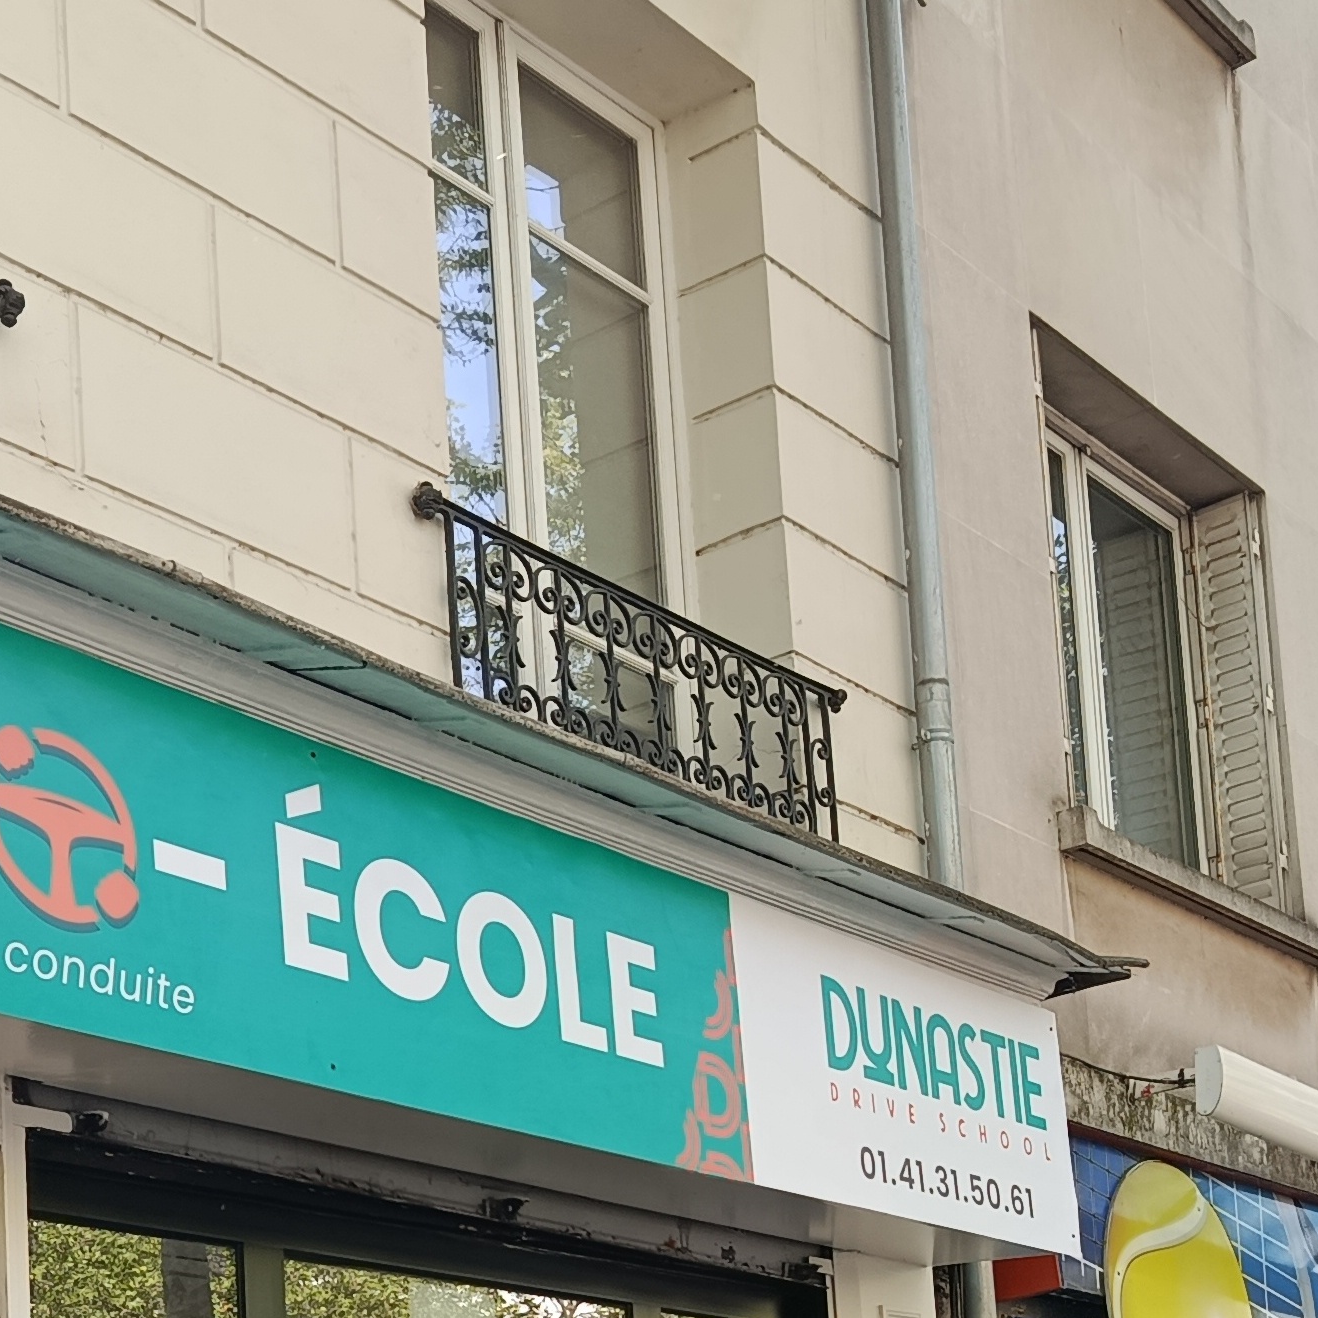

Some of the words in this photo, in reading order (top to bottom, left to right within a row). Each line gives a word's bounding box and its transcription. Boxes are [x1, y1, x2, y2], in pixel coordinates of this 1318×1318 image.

[275, 783, 667, 1069] ÉCOLE
[4, 943, 196, 1015] conduite
[830, 1081, 916, 1125] DRIVE
[938, 1112, 1052, 1162] SCHOOL
[860, 1146, 1035, 1219] 01.41.31.50.61
